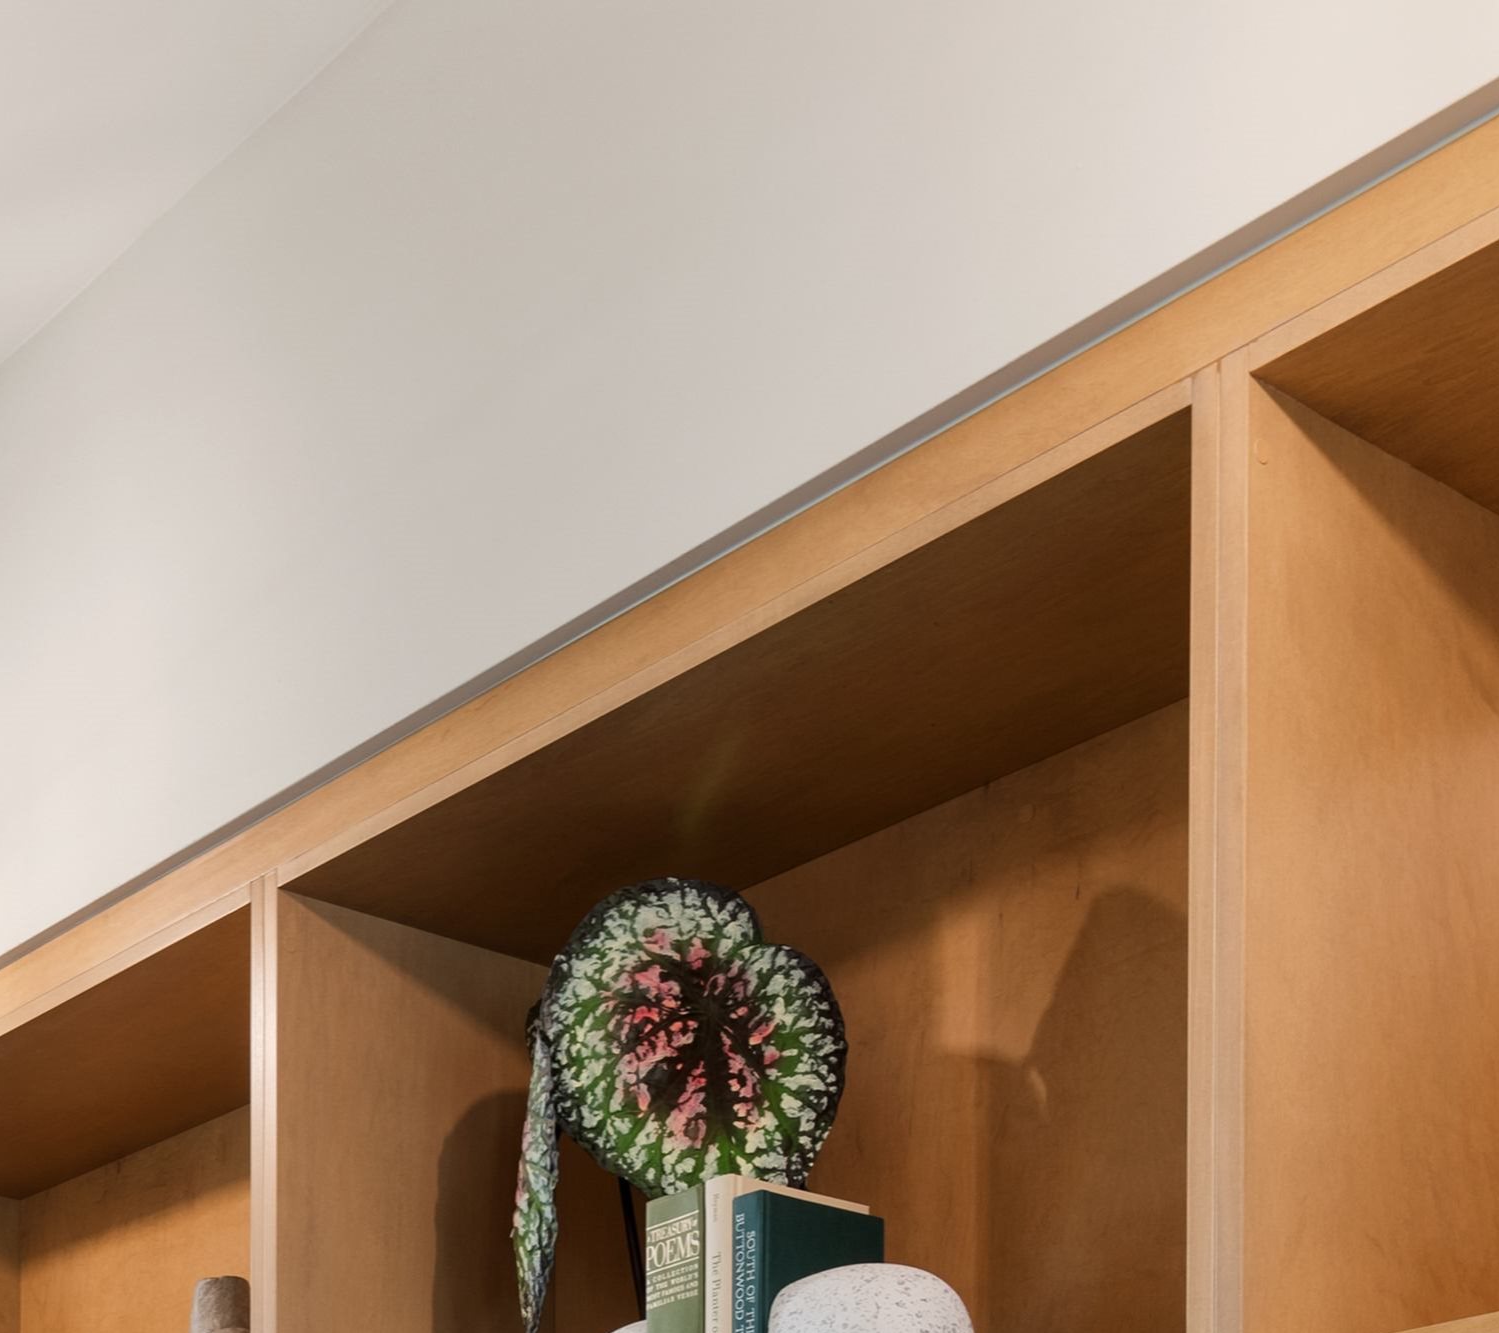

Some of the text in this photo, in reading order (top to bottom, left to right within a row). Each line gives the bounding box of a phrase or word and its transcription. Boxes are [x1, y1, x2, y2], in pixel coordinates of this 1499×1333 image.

[646, 1229, 700, 1268] POEMS
[650, 1219, 692, 1243] TREASURY
[734, 1213, 745, 1320] BUTTONWOOD
[746, 1231, 756, 1280] SOUTH
[746, 1285, 755, 1300] OF
